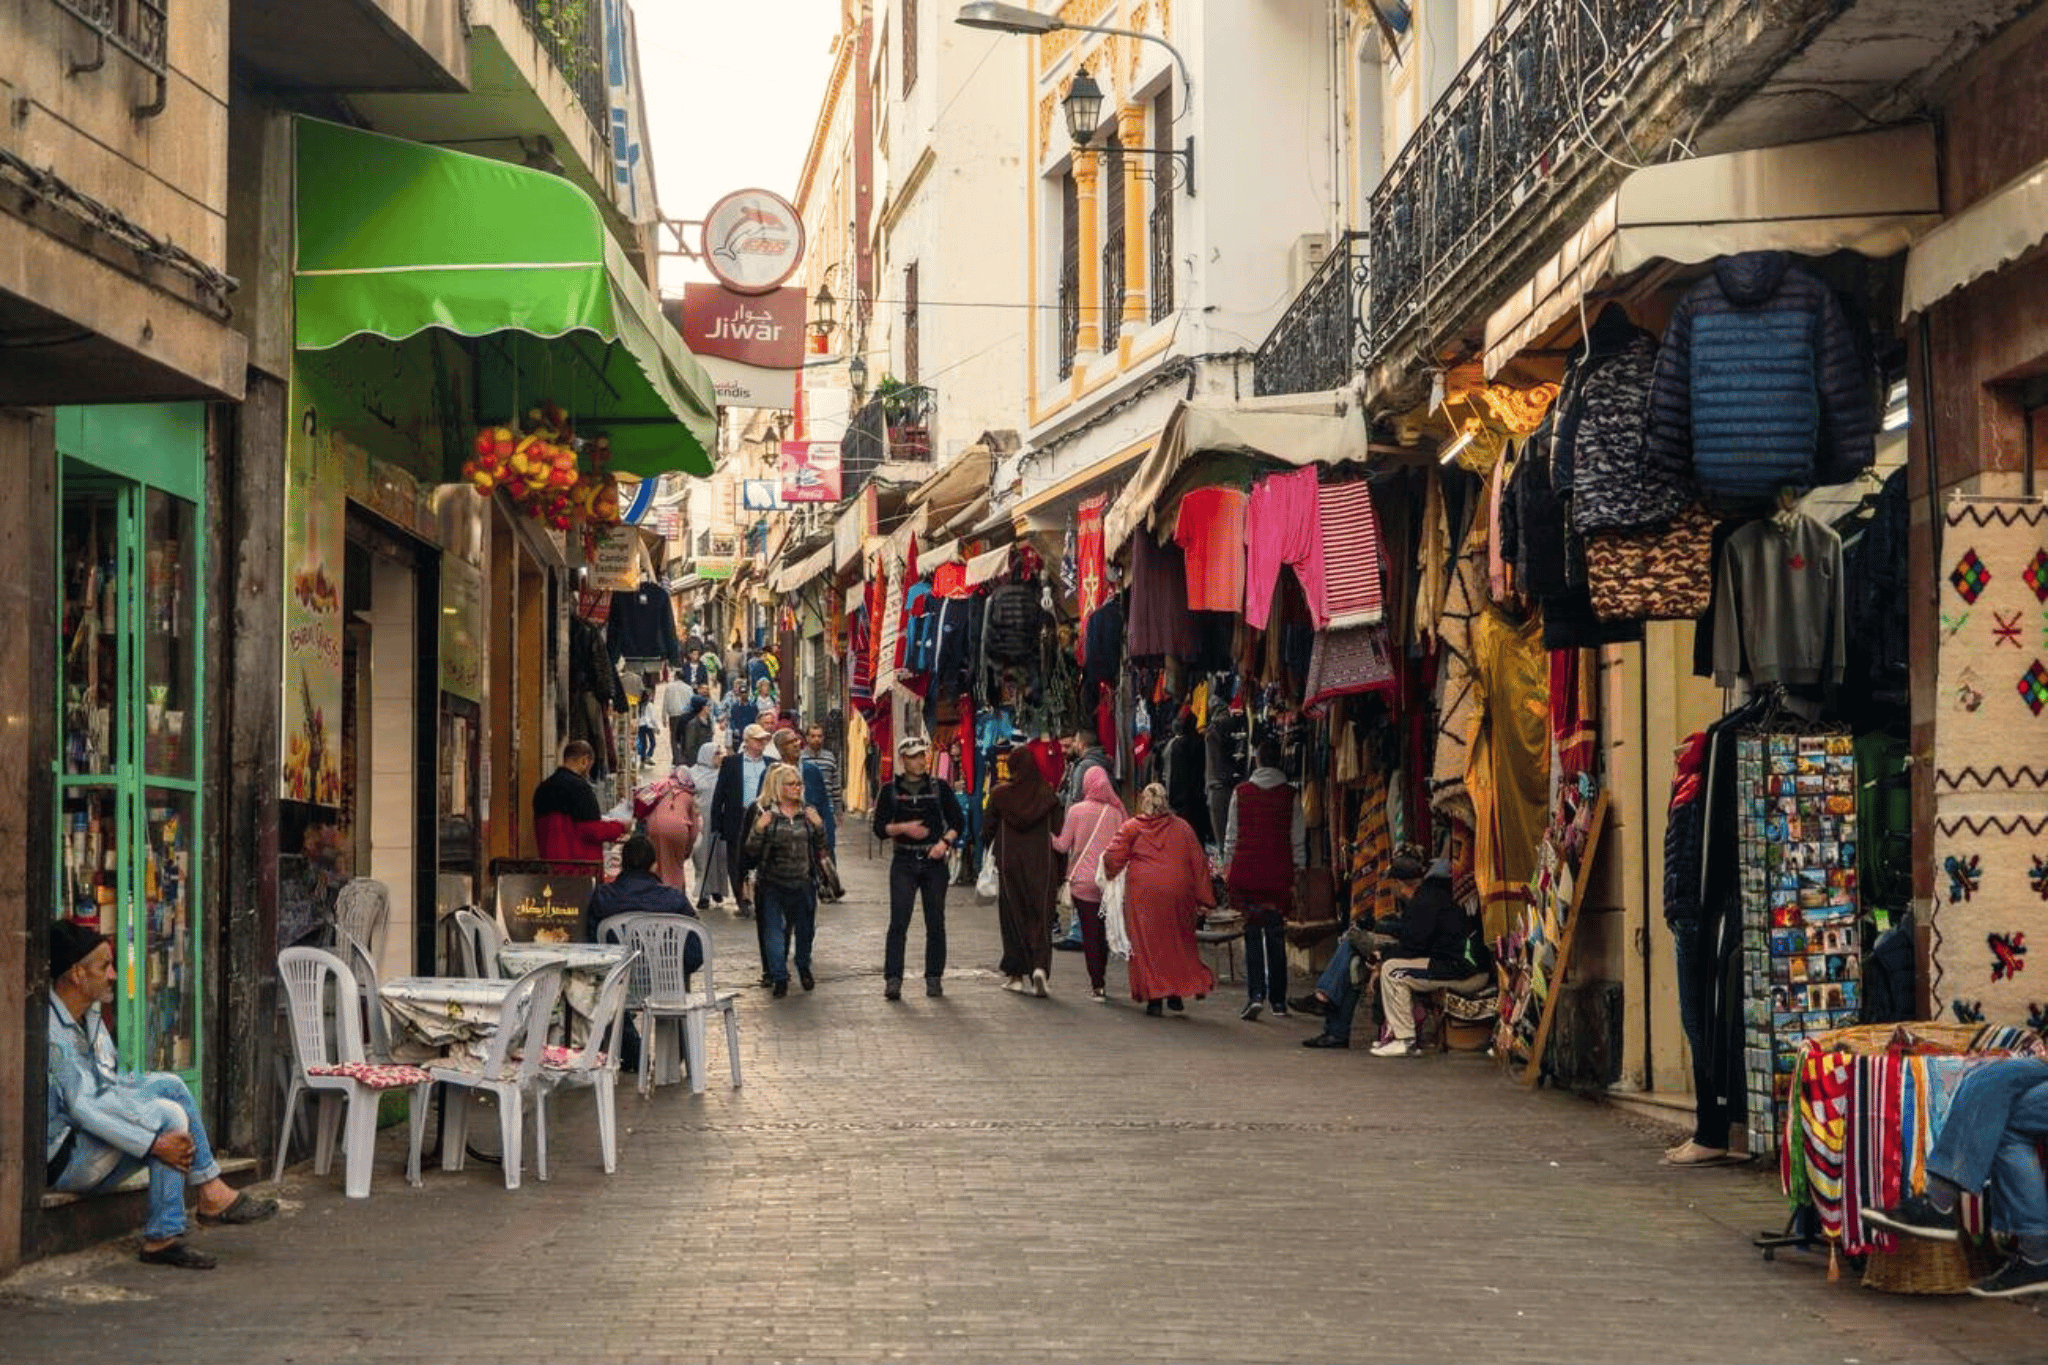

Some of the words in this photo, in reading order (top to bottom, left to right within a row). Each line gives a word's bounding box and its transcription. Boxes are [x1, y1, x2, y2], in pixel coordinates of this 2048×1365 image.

[732, 304, 773, 323] جوار
[705, 316, 783, 342] Jiwar
[716, 387, 751, 398] endis
